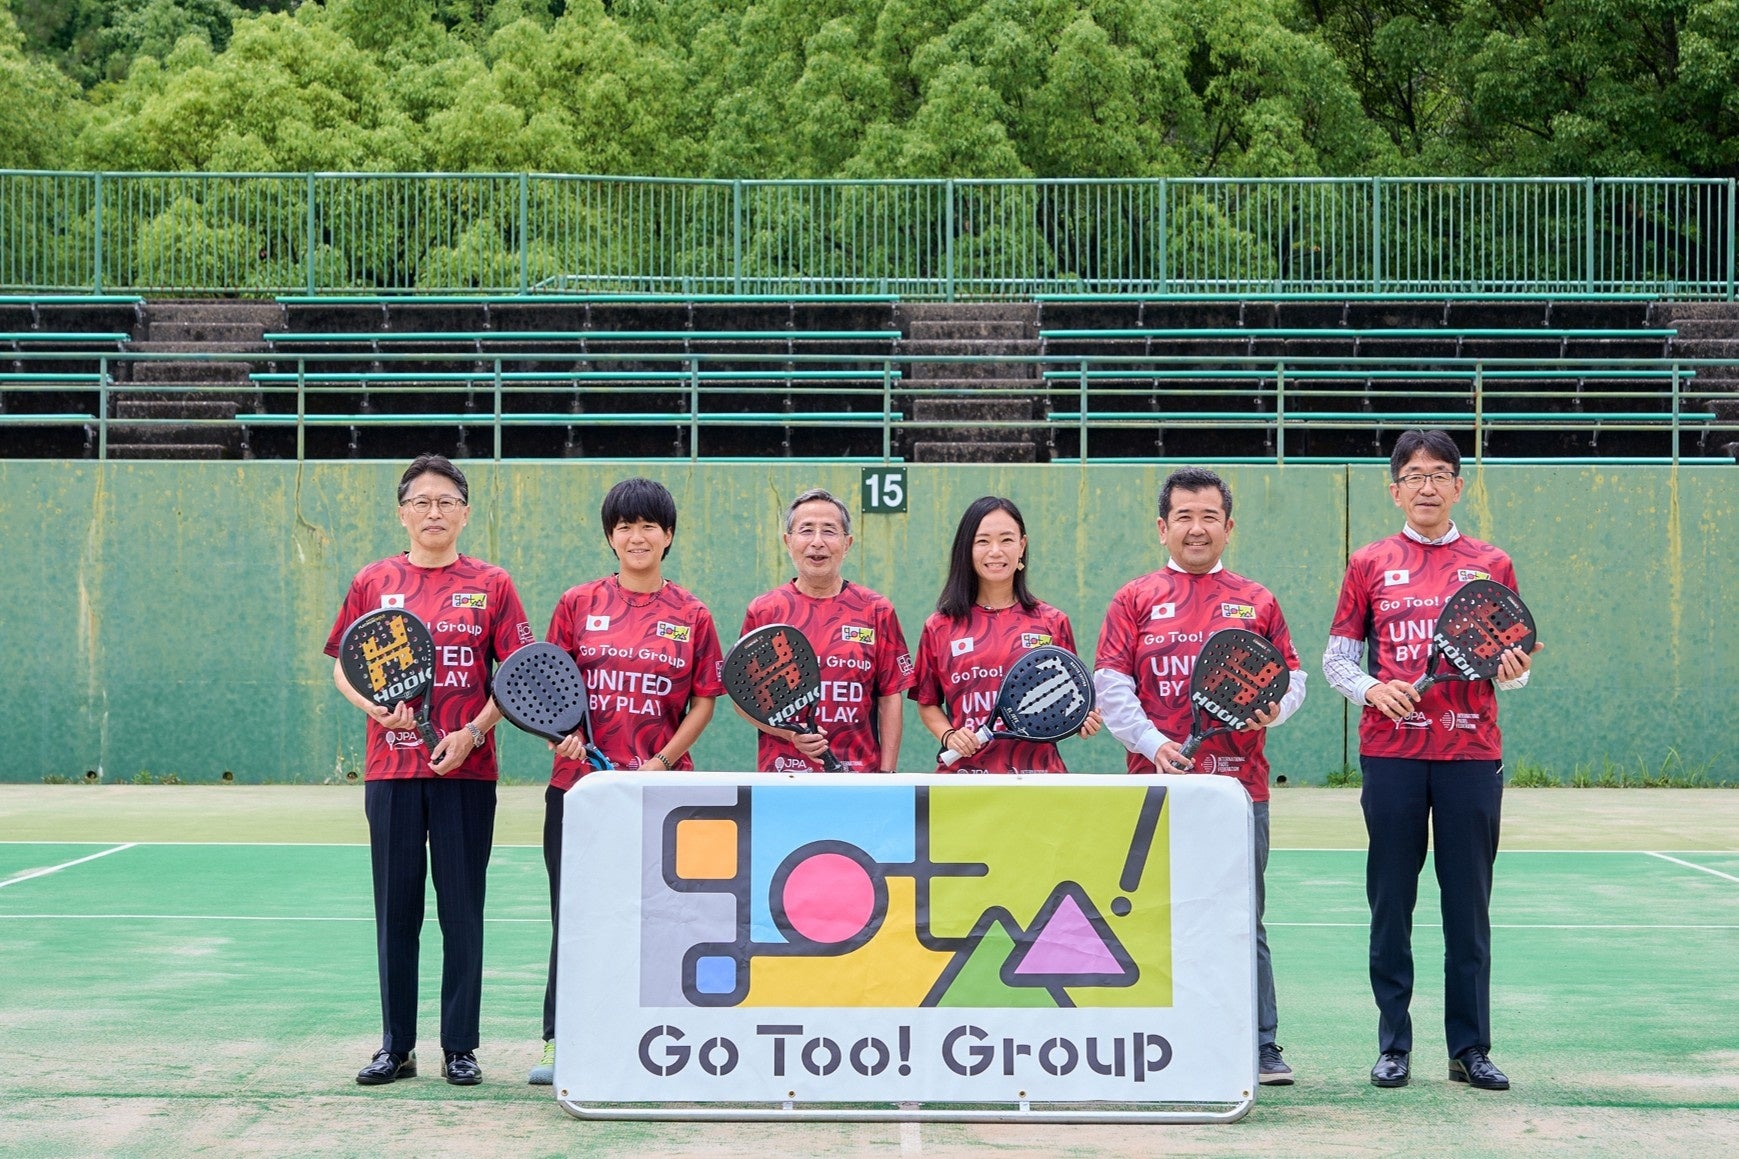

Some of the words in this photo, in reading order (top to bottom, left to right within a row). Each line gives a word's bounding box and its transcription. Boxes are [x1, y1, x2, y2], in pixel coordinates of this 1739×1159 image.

[866, 474, 903, 507] 15
[1380, 600, 1400, 611] Go
[1403, 596, 1439, 608] Too!
[436, 621, 482, 636] Group
[1144, 634, 1164, 645] Go
[1168, 631, 1203, 643] Too!
[1389, 619, 1438, 642] UNI
[579, 645, 596, 656] Go
[599, 645, 634, 658] Too!
[639, 649, 686, 668] Group
[826, 655, 872, 671] Group
[1396, 644, 1421, 662] BY
[1434, 633, 1480, 681] HOOK
[951, 671, 970, 684] Go
[971, 665, 1003, 679] Too!
[1150, 655, 1197, 677] UNI
[373, 667, 432, 703] HOOK
[433, 671, 471, 688] LAY.
[586, 669, 672, 696] UNITED
[1158, 680, 1184, 697] BY
[820, 681, 863, 702] TED
[589, 694, 611, 711] BY
[768, 686, 820, 727] HOOK
[962, 691, 998, 714] UNI
[1192, 691, 1246, 730] HOOK
[396, 732, 417, 741] JPA
[785, 758, 807, 768] JPA
[638, 1024, 739, 1077] Go
[756, 1024, 912, 1077] Too!
[941, 1024, 1173, 1082] Group
